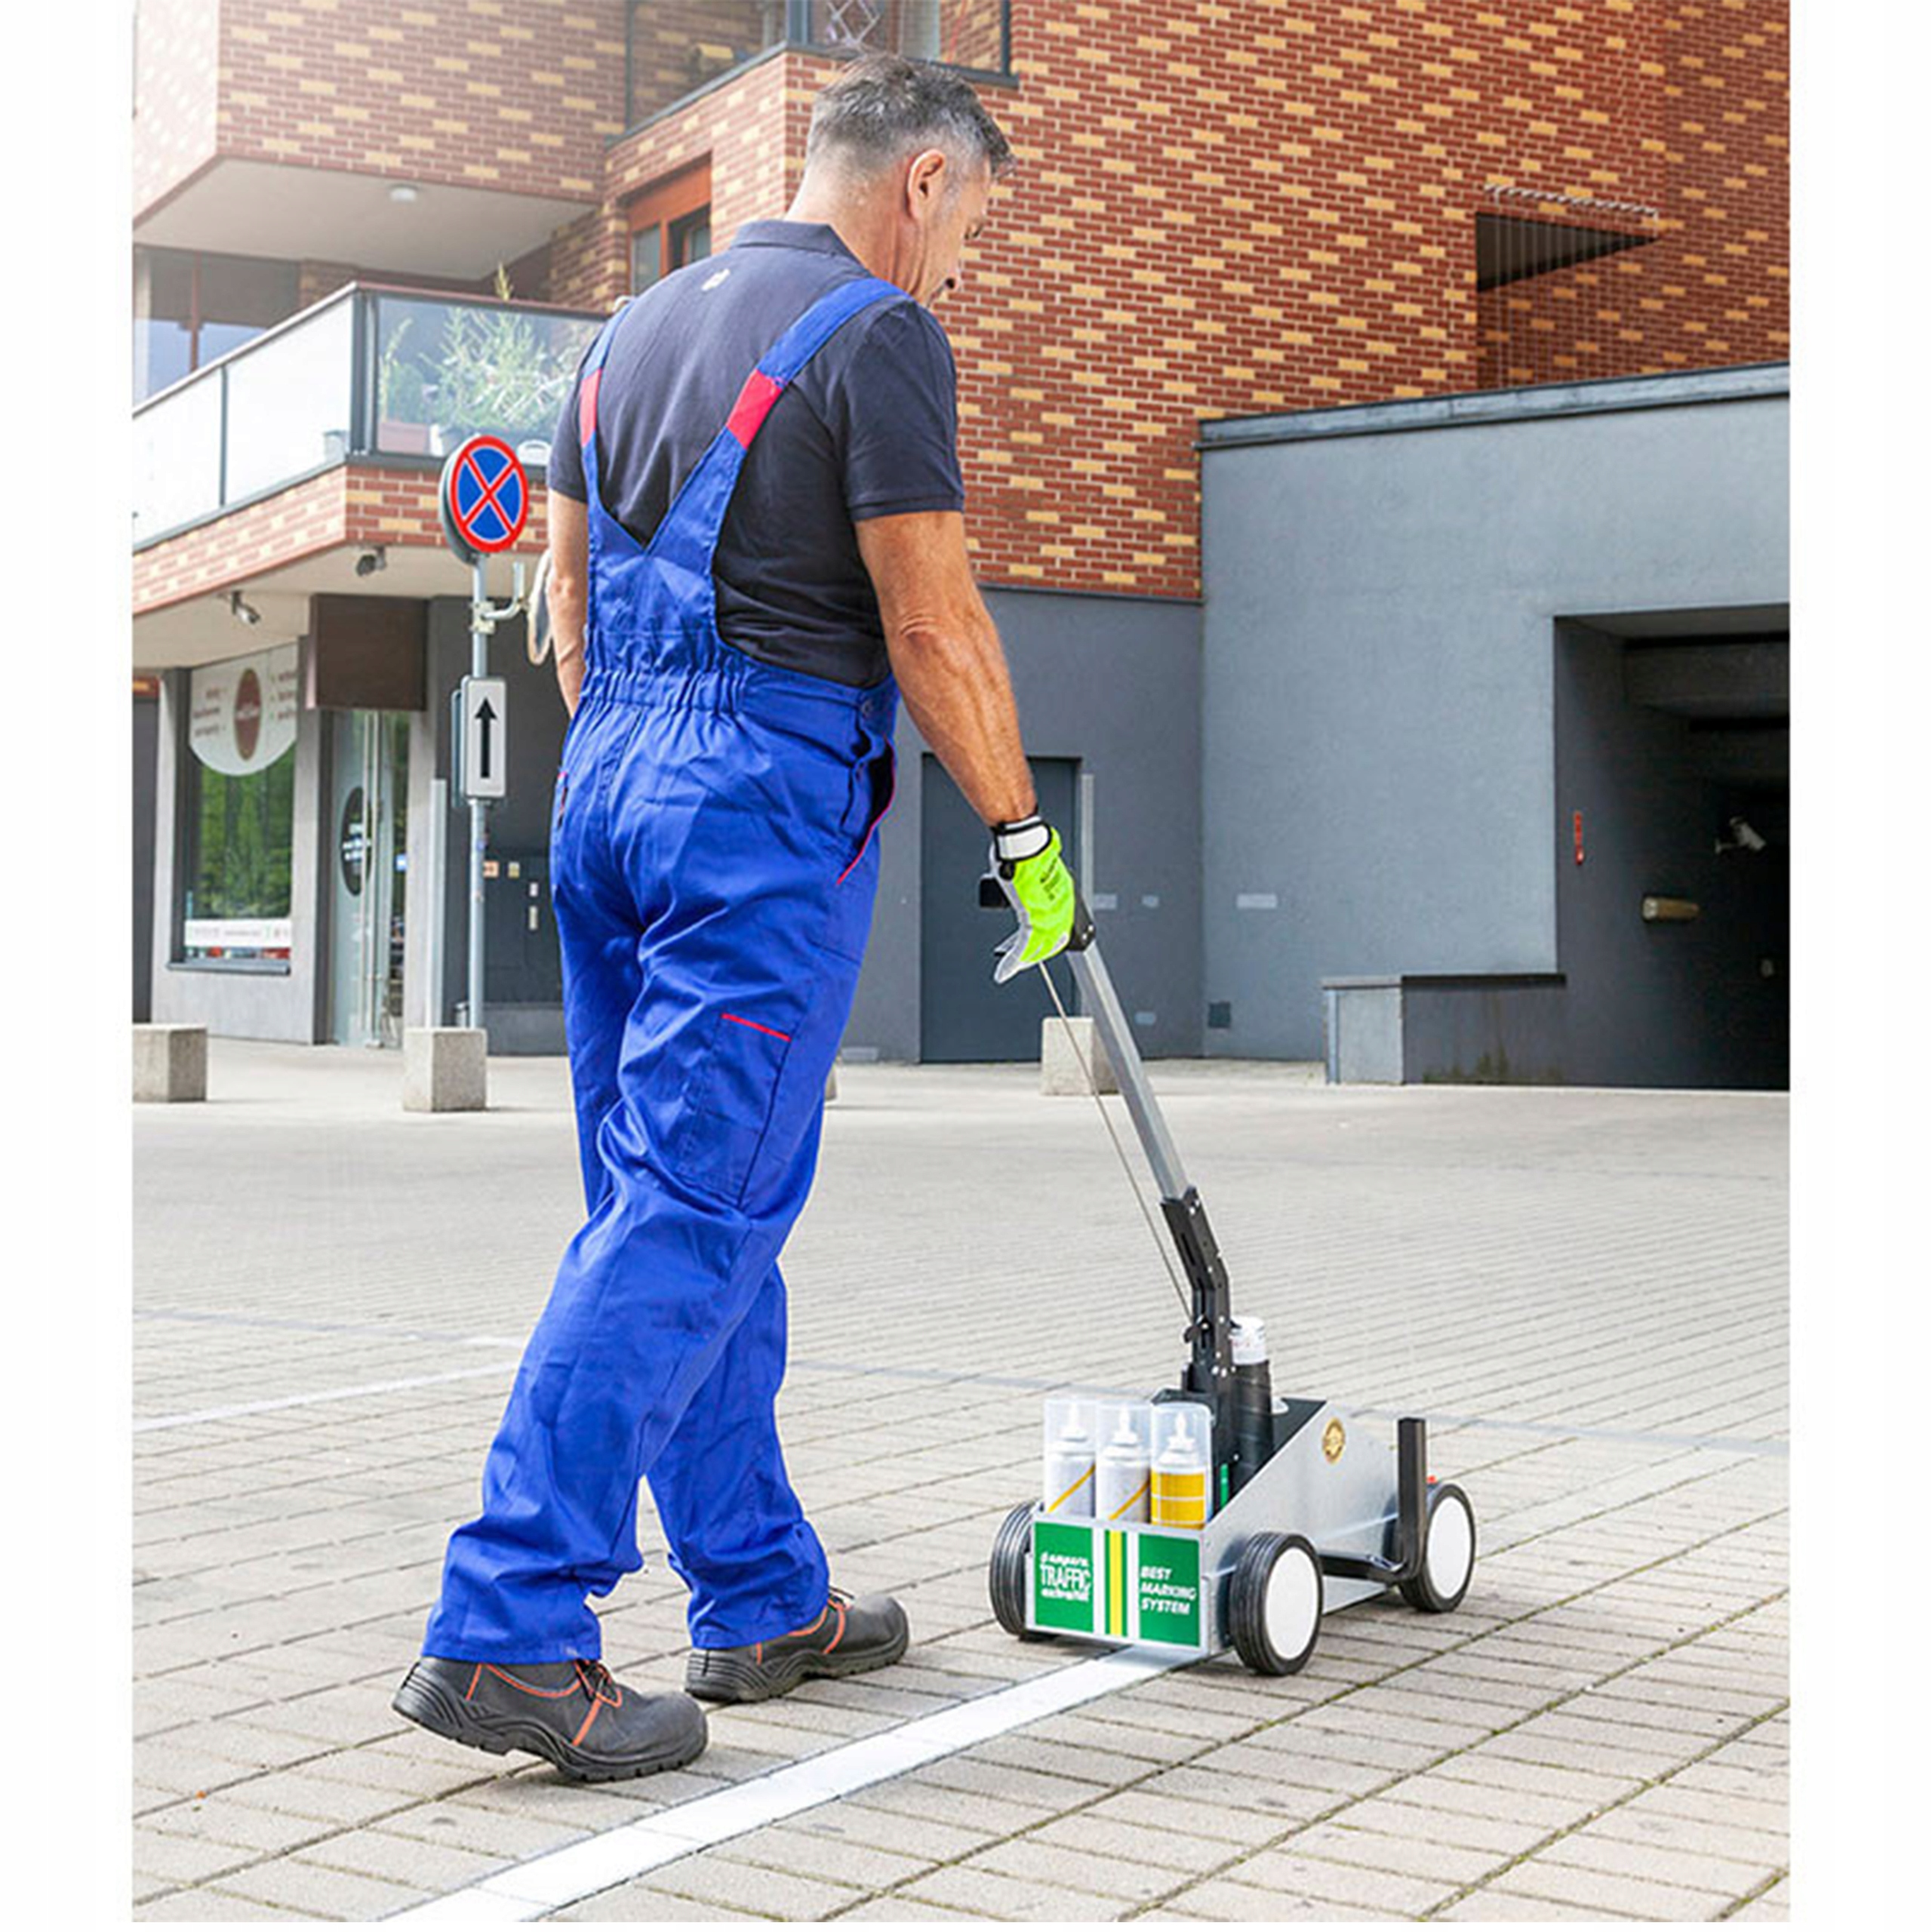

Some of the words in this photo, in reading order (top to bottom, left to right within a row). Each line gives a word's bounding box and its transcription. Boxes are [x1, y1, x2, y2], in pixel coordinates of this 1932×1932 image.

[1040, 1564, 1091, 1590] TRAFFIC
[1141, 1566, 1173, 1581] BEST
[1141, 1582, 1197, 1601] MARKING
[1142, 1598, 1190, 1615] SYSTEM
